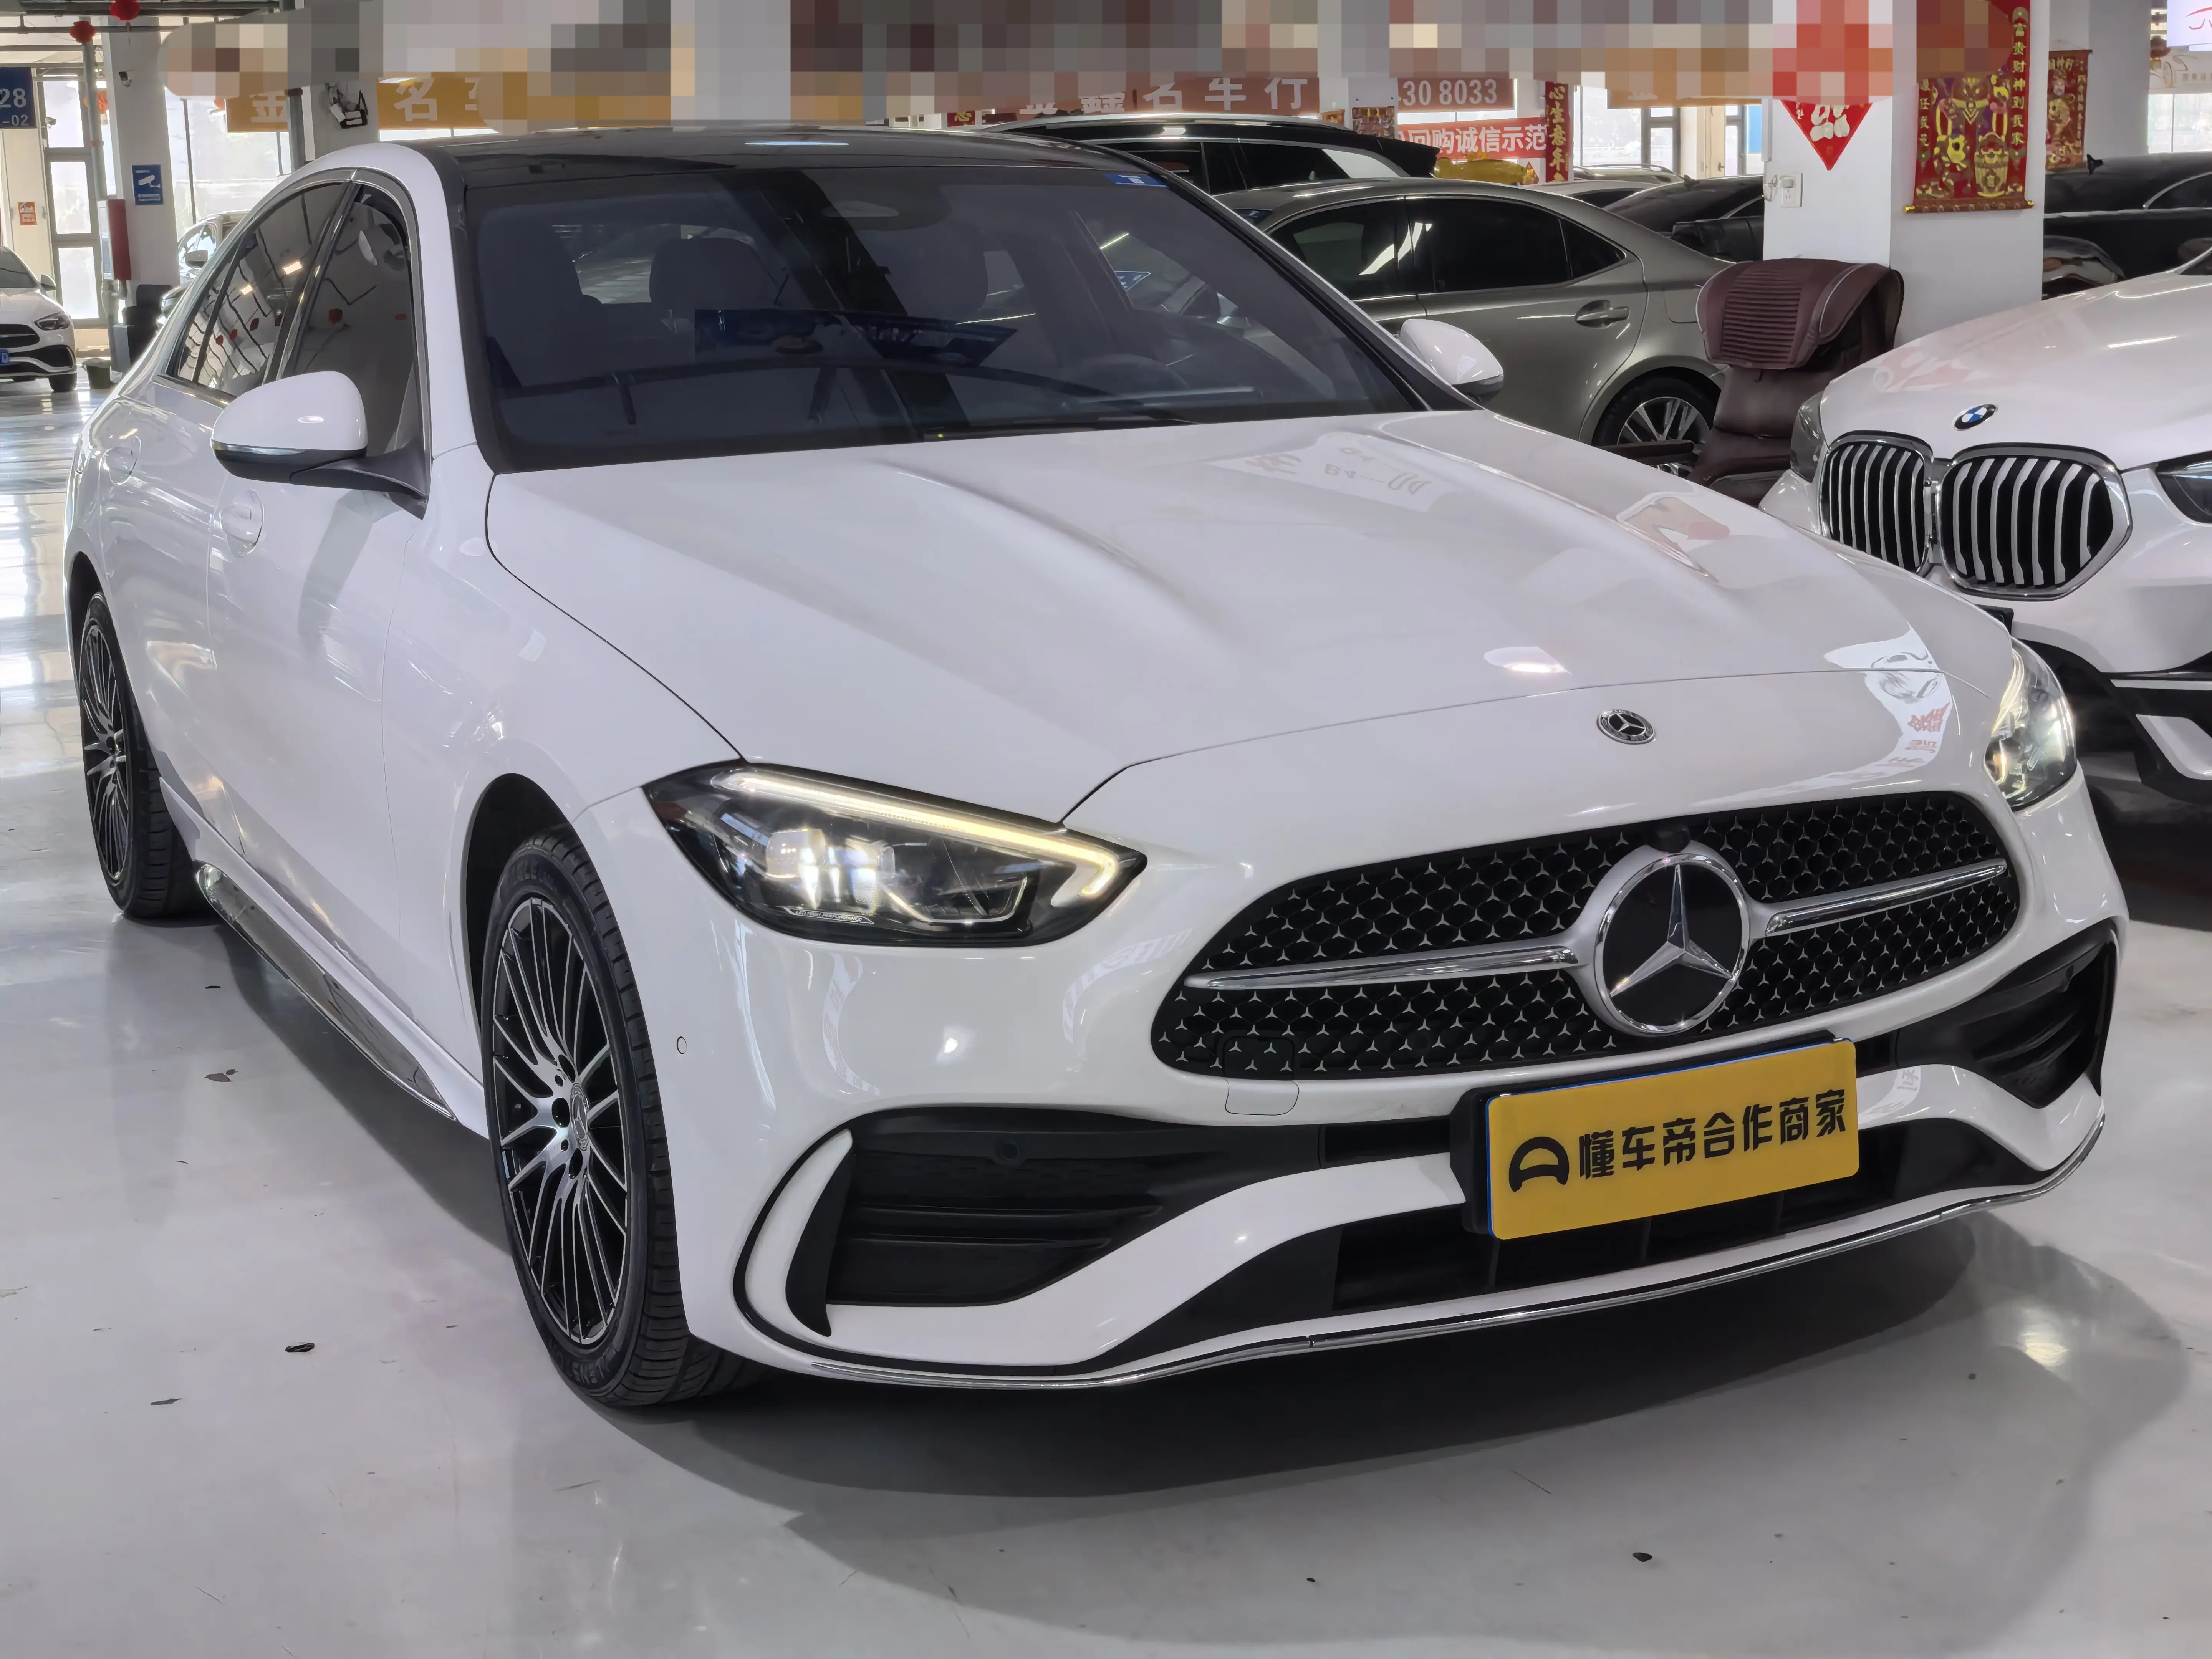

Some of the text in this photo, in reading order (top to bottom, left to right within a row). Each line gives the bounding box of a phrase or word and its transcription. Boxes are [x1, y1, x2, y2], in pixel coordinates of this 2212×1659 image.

[1019, 77, 1307, 114] 名车行
[1402, 79, 1497, 106] 30 8033
[1397, 124, 1547, 154] 回购诚信示范
[822, 913, 863, 922] PERFORMANCE
[1579, 1089, 1846, 1180] 懂车帝合作商家
